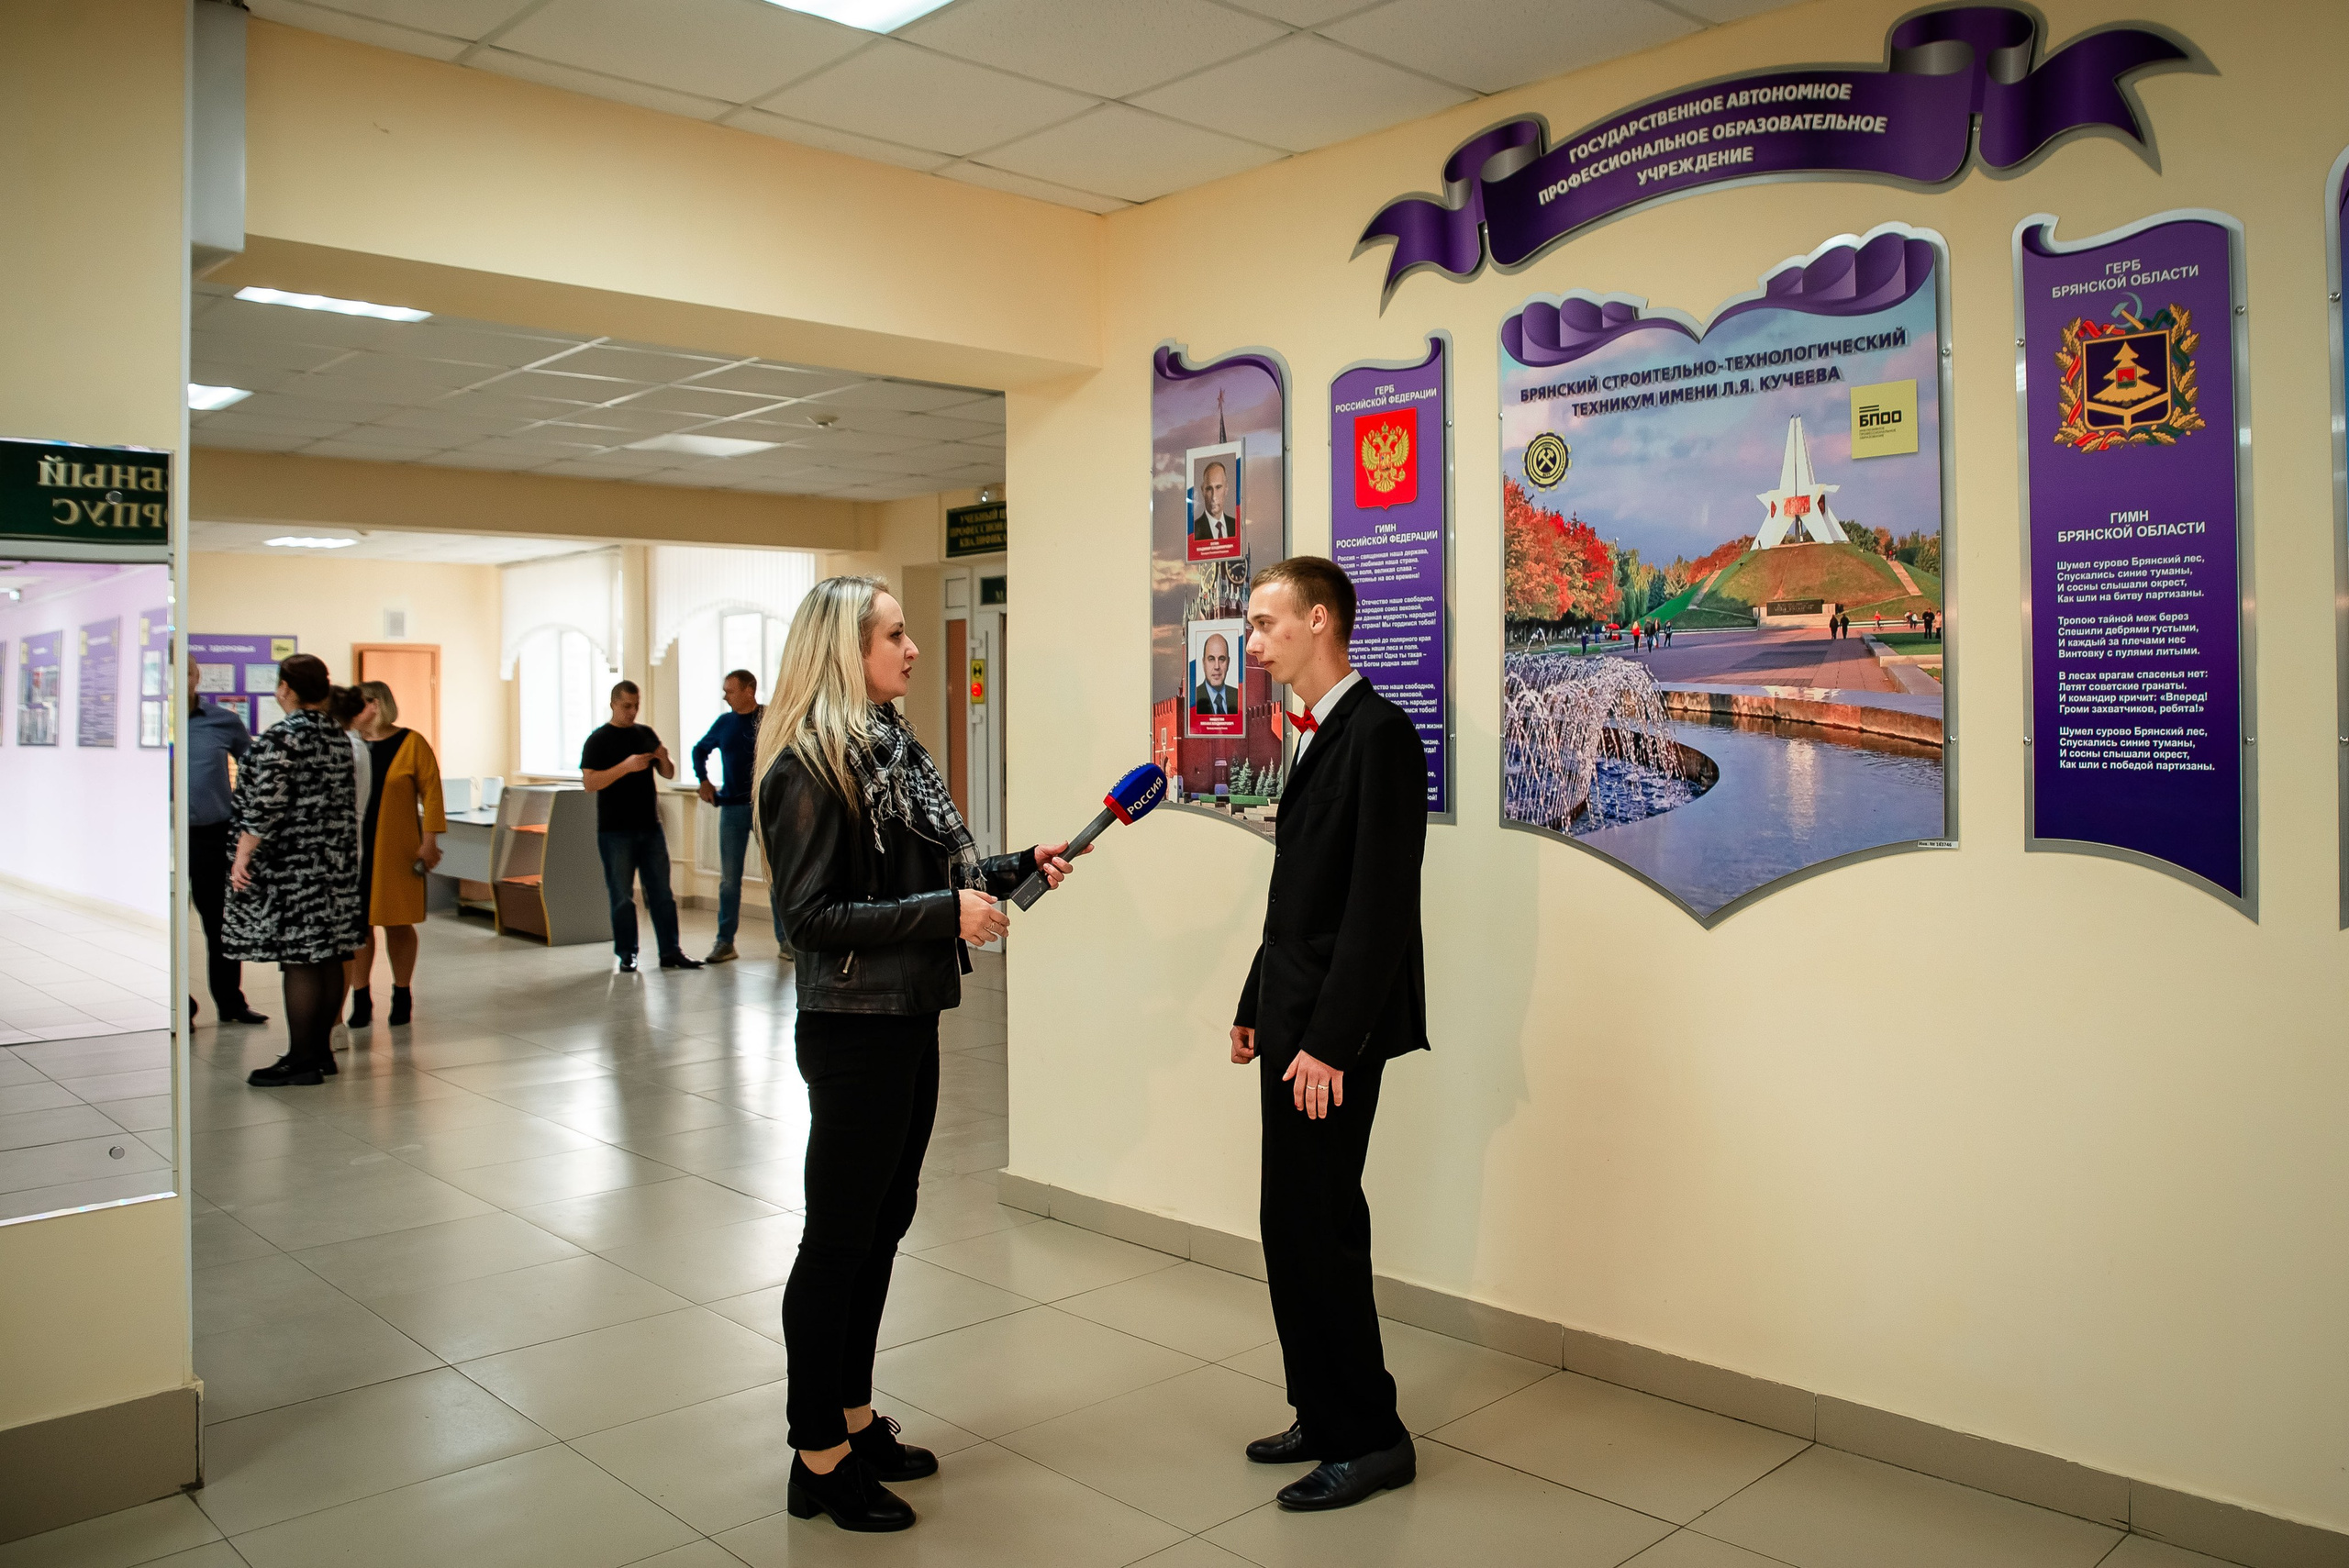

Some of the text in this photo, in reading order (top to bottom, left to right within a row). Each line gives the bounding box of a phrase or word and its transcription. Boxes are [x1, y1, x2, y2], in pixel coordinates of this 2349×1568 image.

[1569, 83, 1852, 163] ГОСУДАРСТВЕННОЕ АВТОНОМНОЕ
[1538, 114, 1887, 206] ПРОФЕССИОНАЛЬНОЕ ОБРАЗОВАТЕЛЬНОЕ
[1637, 146, 1754, 185] УЧРЕЖДЕНИЕ
[2105, 258, 2141, 275] ГЕРБ
[2052, 264, 2199, 298] БРЯНСКОЙ ОБЛАСТИ
[1520, 328, 1908, 402] БРЯНСКИЙ СТРОИТЕЛЬНО-ТЕХНОЛОГИЧЕСКИЙ
[1374, 383, 1395, 396] ГЕРБ
[1572, 366, 1842, 417] ТЕХНИКУМ ИМЕНИ Л.Я. КУЧЕЕВА
[1335, 387, 1437, 413] РОССИЙСКОЙ ФЕДЕРАЦИИ
[1859, 410, 1902, 427] БПОО
[2110, 509, 2149, 524] ГИМН
[1375, 522, 1397, 534] ГИМН
[2057, 520, 2206, 543] БРЯНСКОЙ ОБЛАСТИ
[1336, 529, 1438, 549] РОССИЙСКОЙ ФЕДЕРАЦИИ
[2056, 554, 2205, 572] Шумел сурово Брянский лес,
[2056, 567, 2193, 583] Спускались синие туманы,
[2057, 578, 2188, 592] И сосны слышали окрест,
[2057, 589, 2205, 603] Как шли на битву партизаны.
[2057, 611, 2190, 627] Тропою тайной меж берез
[2057, 624, 2199, 636] Спешили дебрями густыми,
[2058, 636, 2186, 648] И каждый за плечами нес
[2058, 647, 2200, 659] Винтовку с пулями литыми.
[2058, 670, 2208, 681] В лесах врагам спасенья нет:
[1404, 682, 1436, 690] свободное,
[2058, 681, 2187, 692] Летят советские гранаты.
[2059, 691, 2208, 704] И командир кричит: «Вперед!
[2059, 703, 2205, 715] Громи захватчиков, ребята!»
[2059, 726, 2208, 738] Шумел сурово Брянский лес,
[2059, 737, 2196, 749] Спускались синие туманы,
[2059, 748, 2190, 760] И сосны слышали окрест,
[2059, 759, 2077, 769] Как
[2101, 761, 2108, 769] с
[2109, 759, 2154, 771] победой
[2156, 762, 2215, 772] партизаны.
[1127, 777, 1163, 815] РОССИЯ
